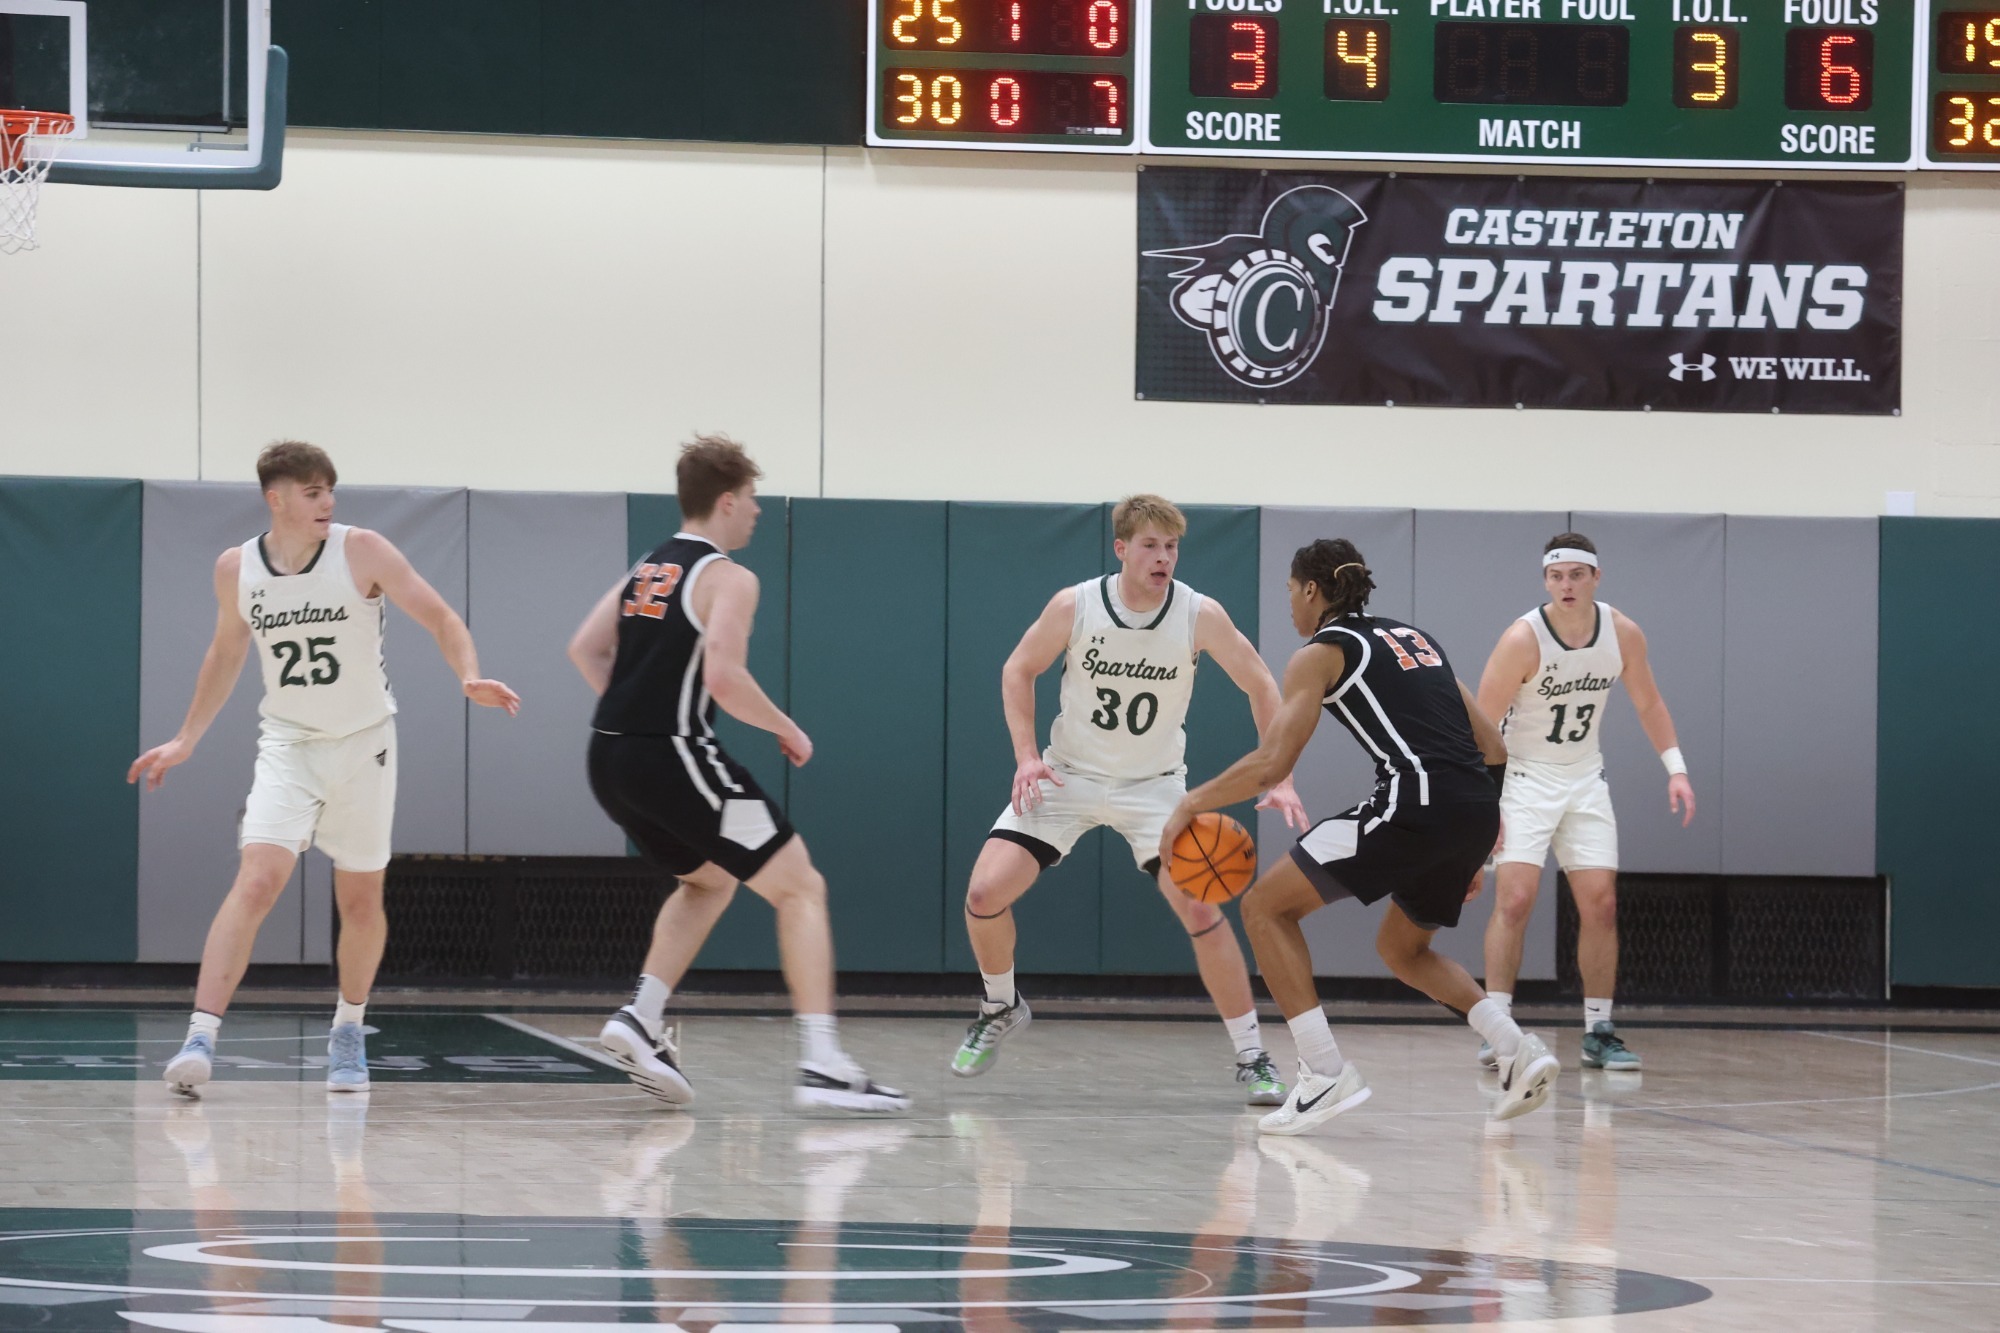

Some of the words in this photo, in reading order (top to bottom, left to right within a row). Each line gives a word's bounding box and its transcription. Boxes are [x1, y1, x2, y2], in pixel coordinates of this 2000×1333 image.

[892, 0, 962, 43] 25
[1011, 2, 1021, 41] 1
[1430, 0, 1541, 19] PLAYER
[1672, 0, 1748, 23] T.O.L.
[1784, 0, 1879, 25] FOULS
[1231, 21, 1265, 91] 3
[1337, 30, 1377, 89] 4
[1691, 33, 1725, 102] 3
[1821, 36, 1860, 104] 6
[897, 74, 962, 124] 30
[1185, 111, 1281, 142] SCORE
[1478, 118, 1582, 150] MATCH
[1780, 124, 1876, 155] SCORE
[1444, 207, 1744, 250] CASTLETON
[1372, 256, 1869, 330] SPARTANS
[1255, 280, 1304, 352] C
[1728, 356, 1778, 380] WE
[1780, 357, 1871, 382] WILL.
[251, 602, 349, 637] Spartans
[271, 636, 342, 688] 25
[1081, 648, 1178, 680] Spartans
[1372, 627, 1443, 671] 13
[1090, 686, 1159, 736] 30
[1545, 703, 1596, 744] 13
